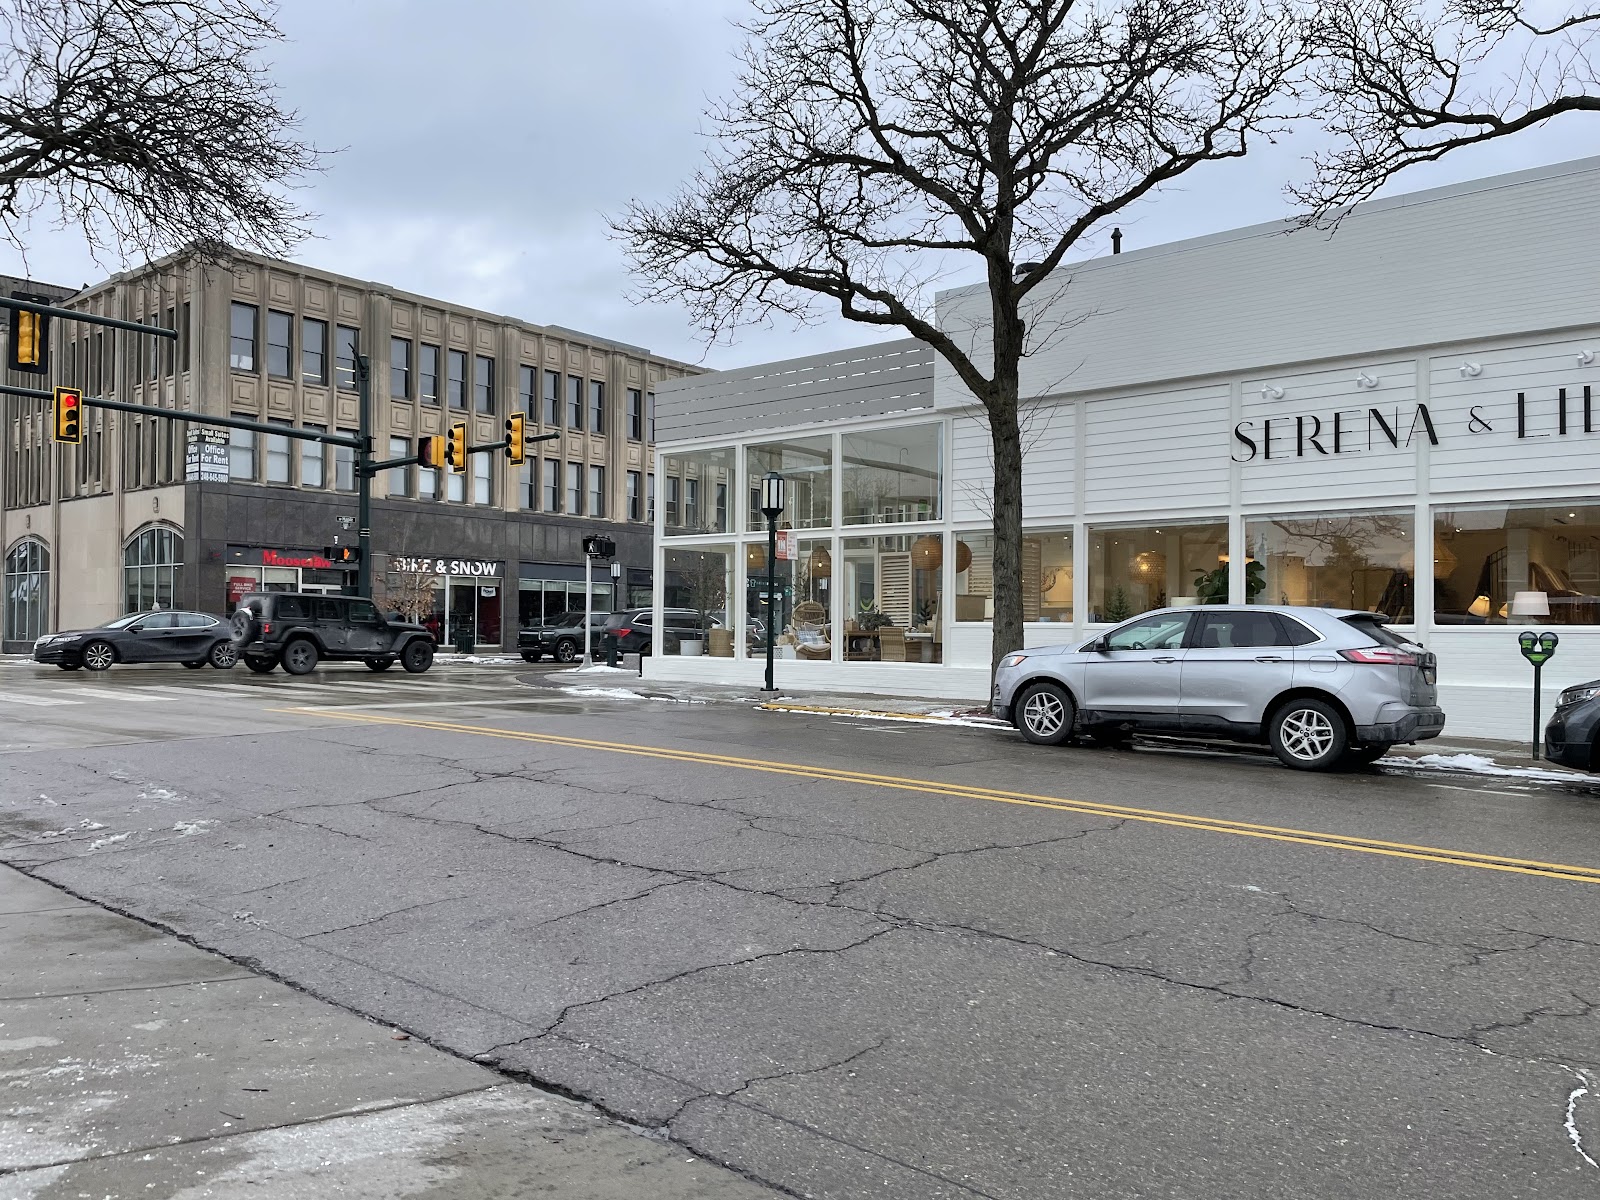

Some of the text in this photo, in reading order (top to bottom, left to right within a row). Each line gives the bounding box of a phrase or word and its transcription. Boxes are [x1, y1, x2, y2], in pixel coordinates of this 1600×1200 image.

[1231, 403, 1439, 463] SERENA
[1468, 405, 1493, 433] &
[205, 444, 225, 455] Office
[201, 453, 228, 465] For Rent
[435, 560, 447, 574] &
[450, 560, 496, 576] SNOW
